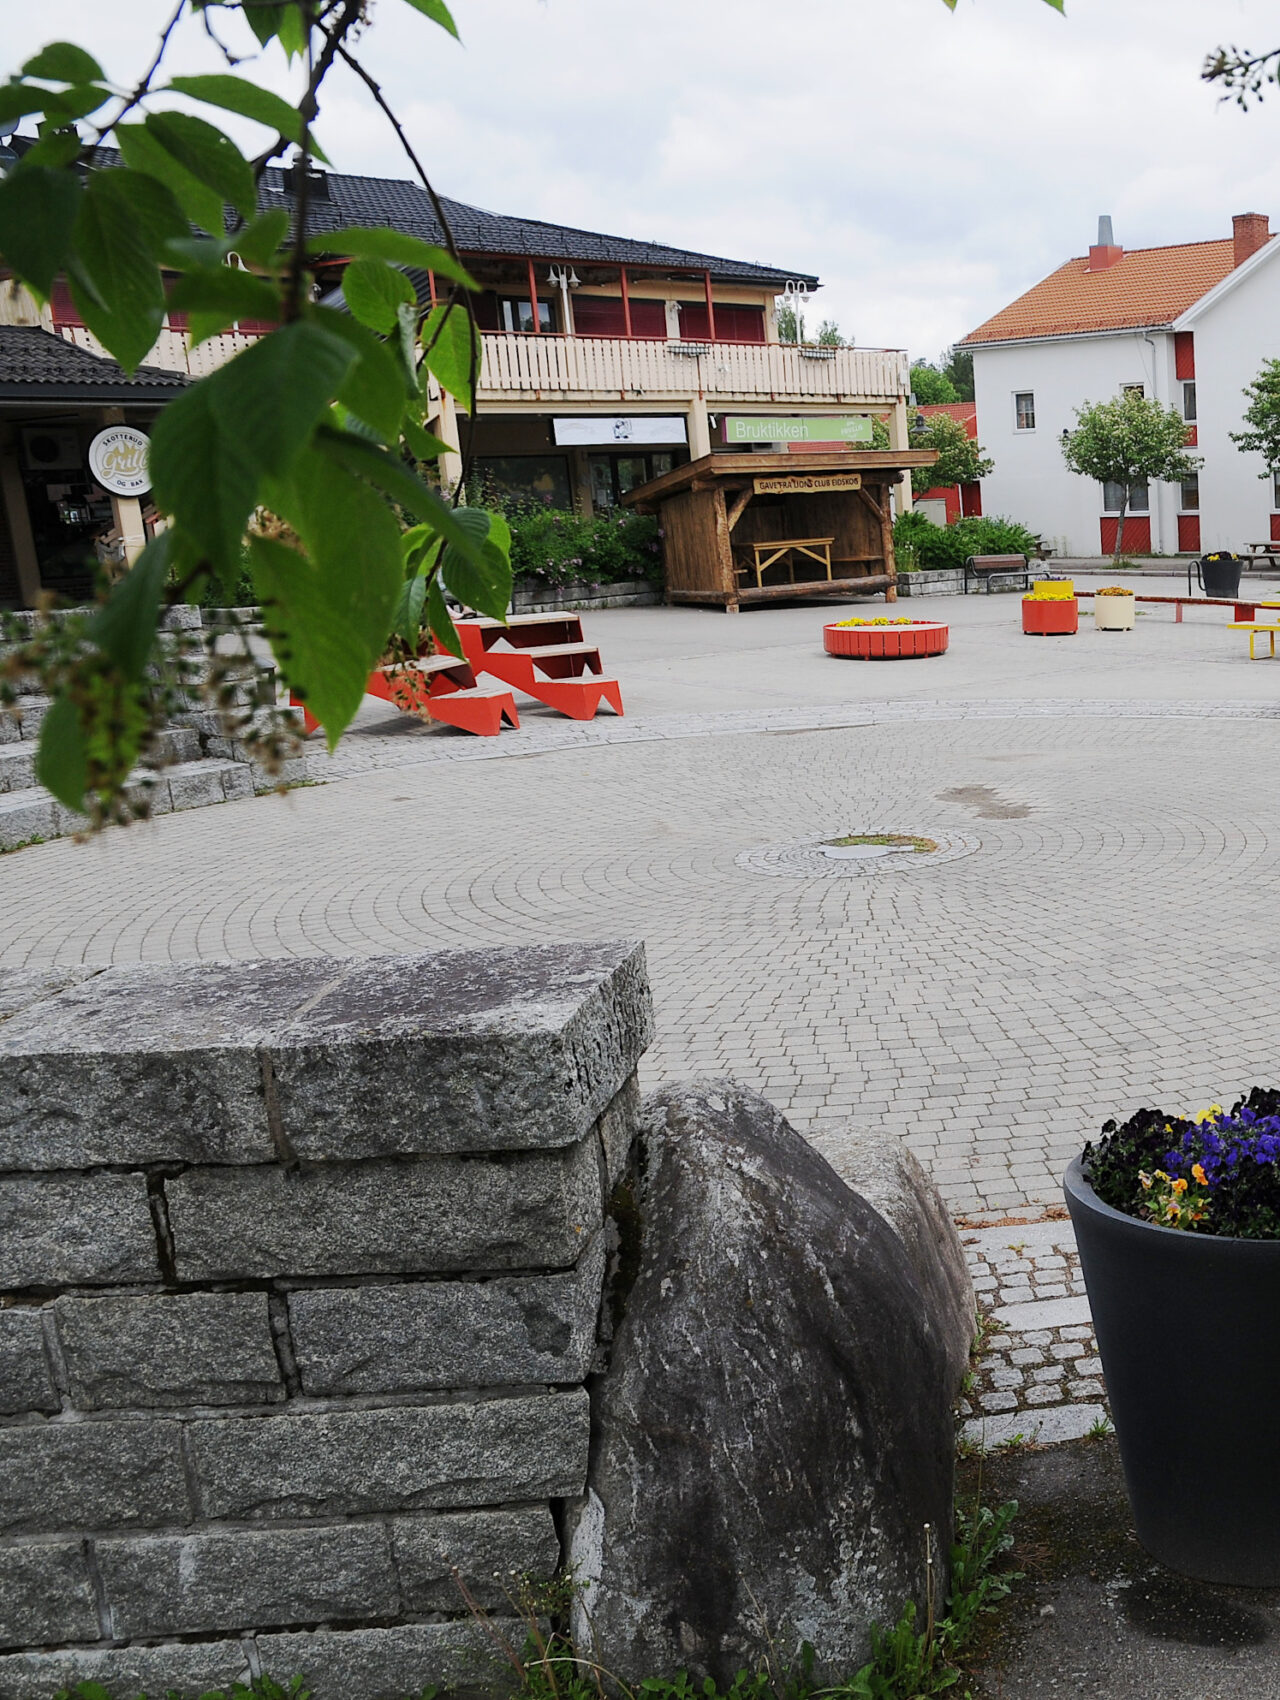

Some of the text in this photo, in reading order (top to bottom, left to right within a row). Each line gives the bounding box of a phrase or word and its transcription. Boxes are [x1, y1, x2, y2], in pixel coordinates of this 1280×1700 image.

[735, 421, 809, 438] Bruktikken
[760, 481, 777, 490] GAVE
[780, 481, 792, 489] FRA
[814, 479, 830, 488] CLUB
